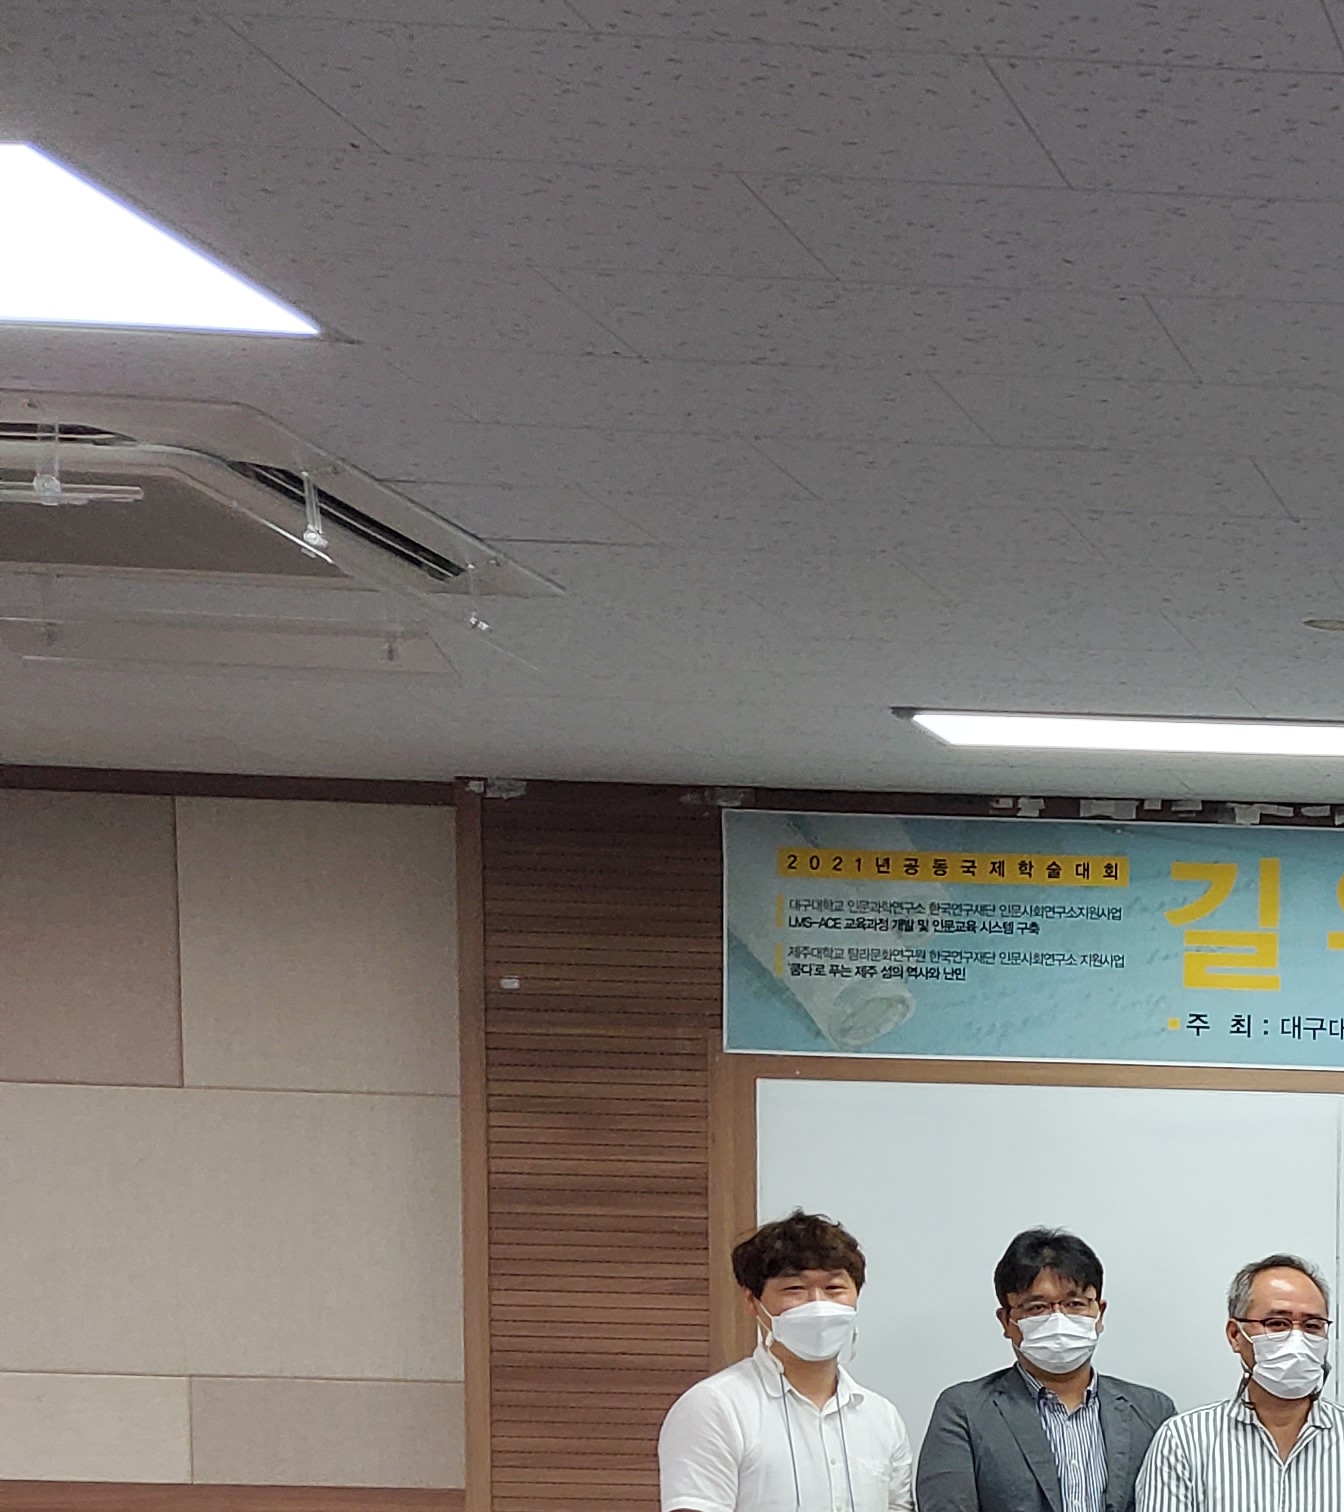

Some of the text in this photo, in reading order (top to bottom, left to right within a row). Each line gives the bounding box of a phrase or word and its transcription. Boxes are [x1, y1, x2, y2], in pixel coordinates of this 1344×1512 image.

[844, 917, 889, 932] 교육과정
[892, 919, 914, 932] 개발
[918, 919, 929, 933] 및
[932, 919, 978, 934] 인문교육
[980, 921, 1014, 935] 시스템
[1017, 922, 1041, 935] 구축
[1163, 858, 1282, 991] 길
[788, 946, 845, 960] 제주대학교
[855, 965, 878, 979] 제주
[881, 965, 904, 979] 섬의
[906, 966, 941, 981] 역사와
[944, 967, 966, 981] 난민
